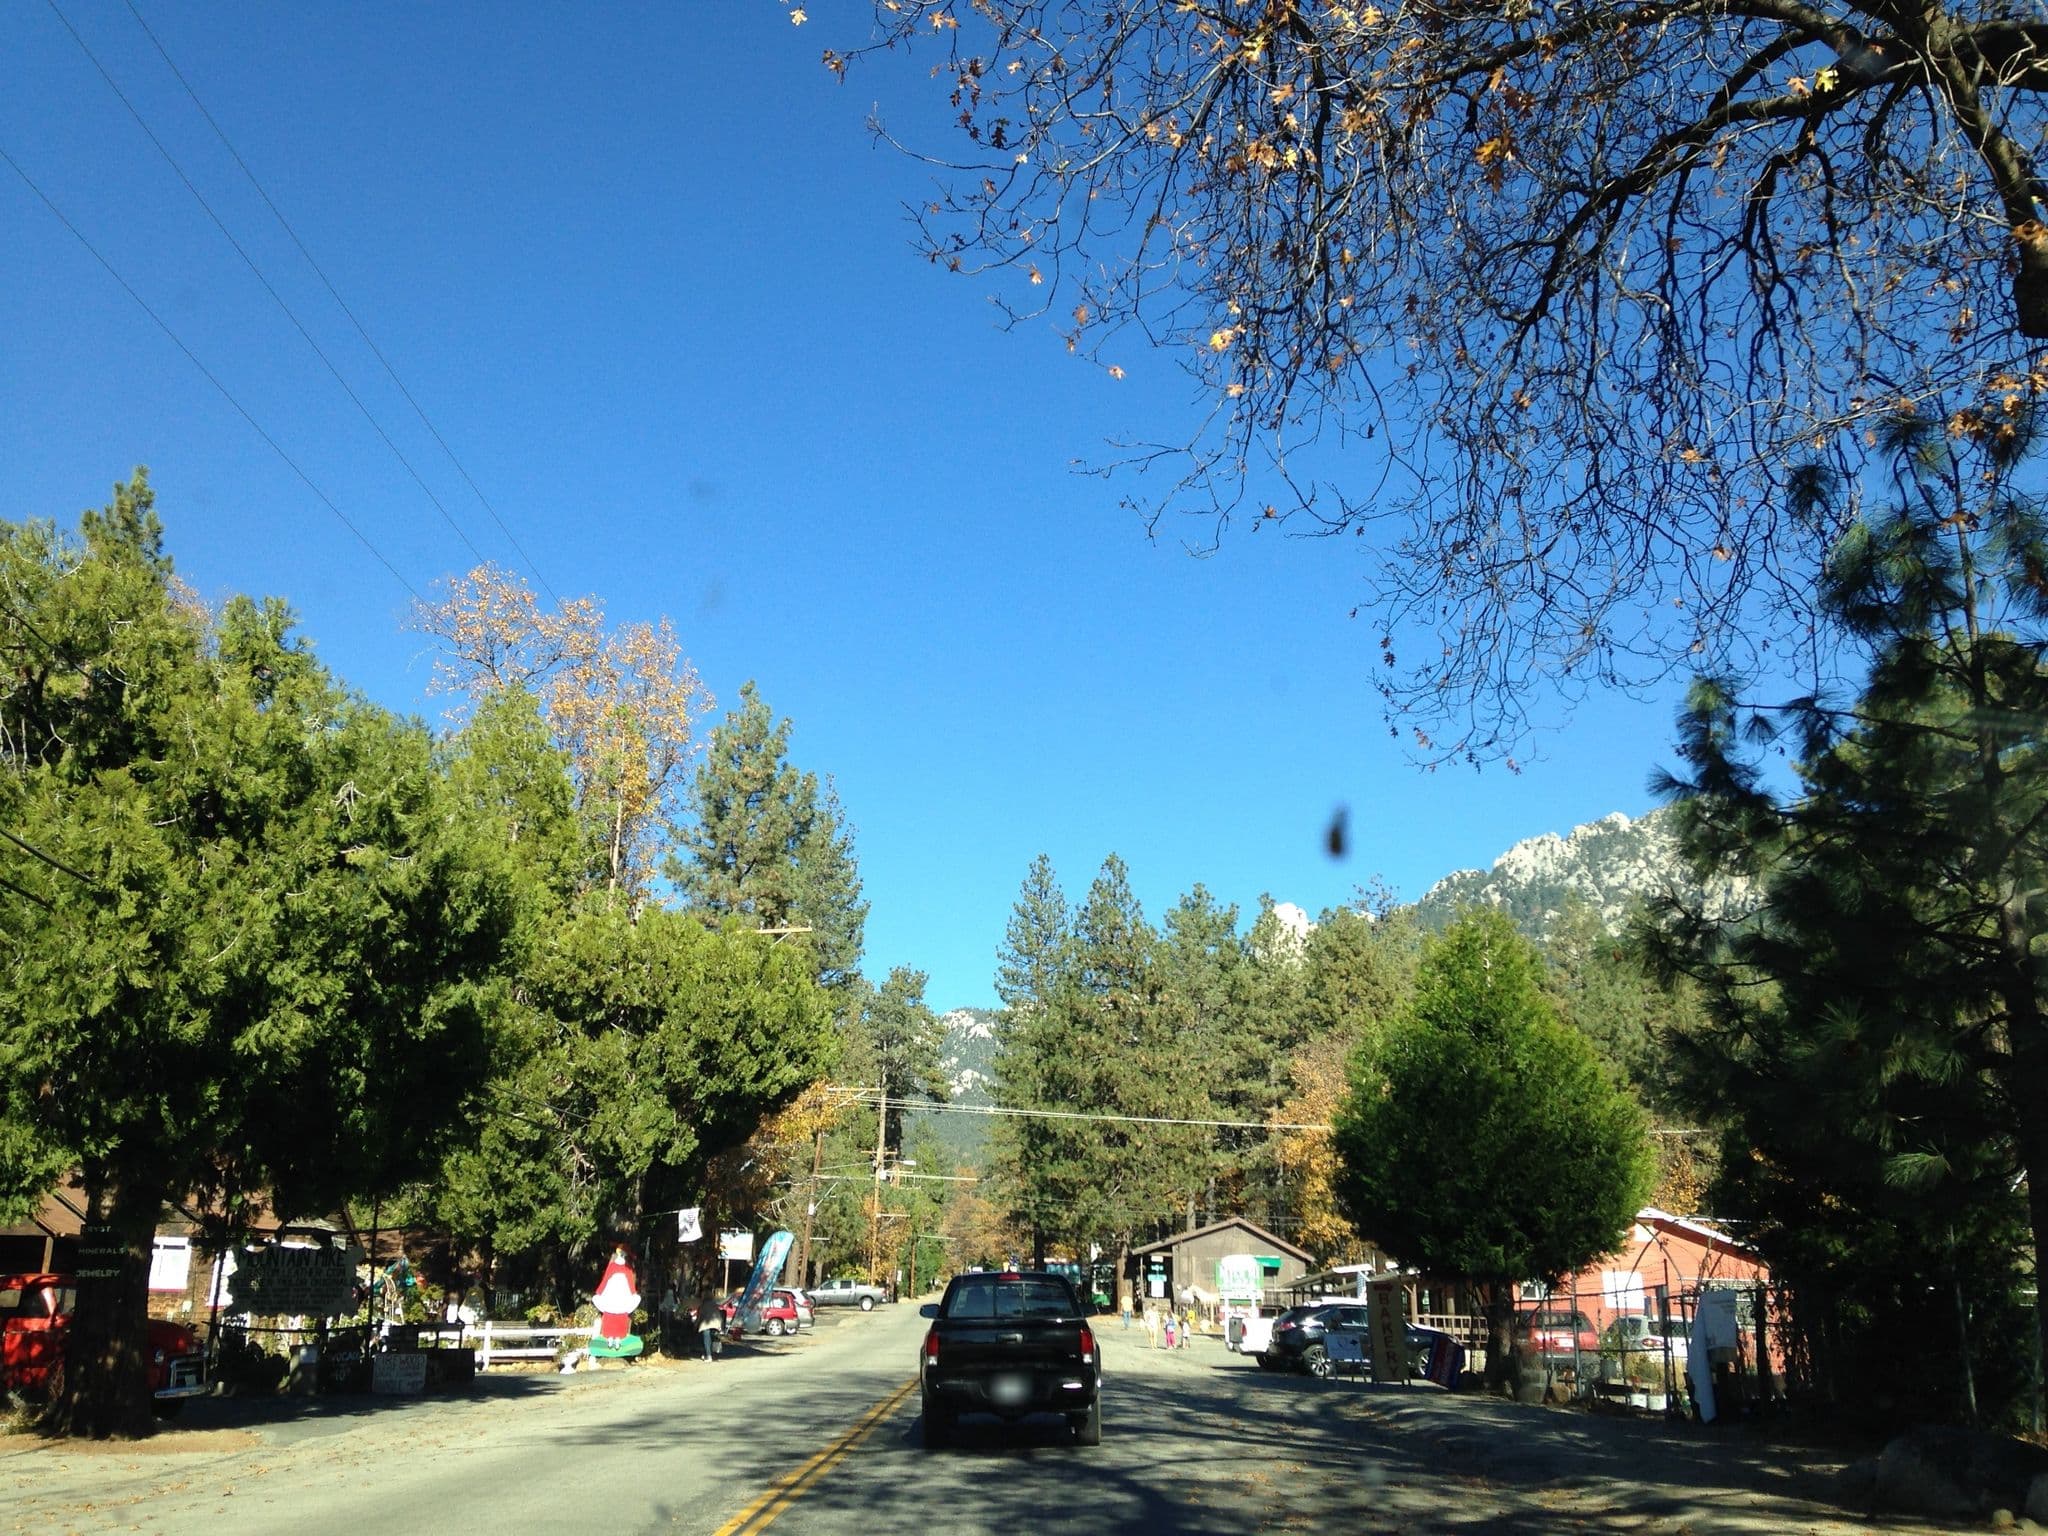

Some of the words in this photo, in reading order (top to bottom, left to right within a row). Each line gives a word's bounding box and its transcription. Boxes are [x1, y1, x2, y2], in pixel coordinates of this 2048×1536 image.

[239, 1248, 311, 1267] MOUNTAIN
[314, 1248, 346, 1267] MIKE
[75, 1268, 121, 1279] JEWELRY
[1378, 1293, 1398, 1377] BAKERY
